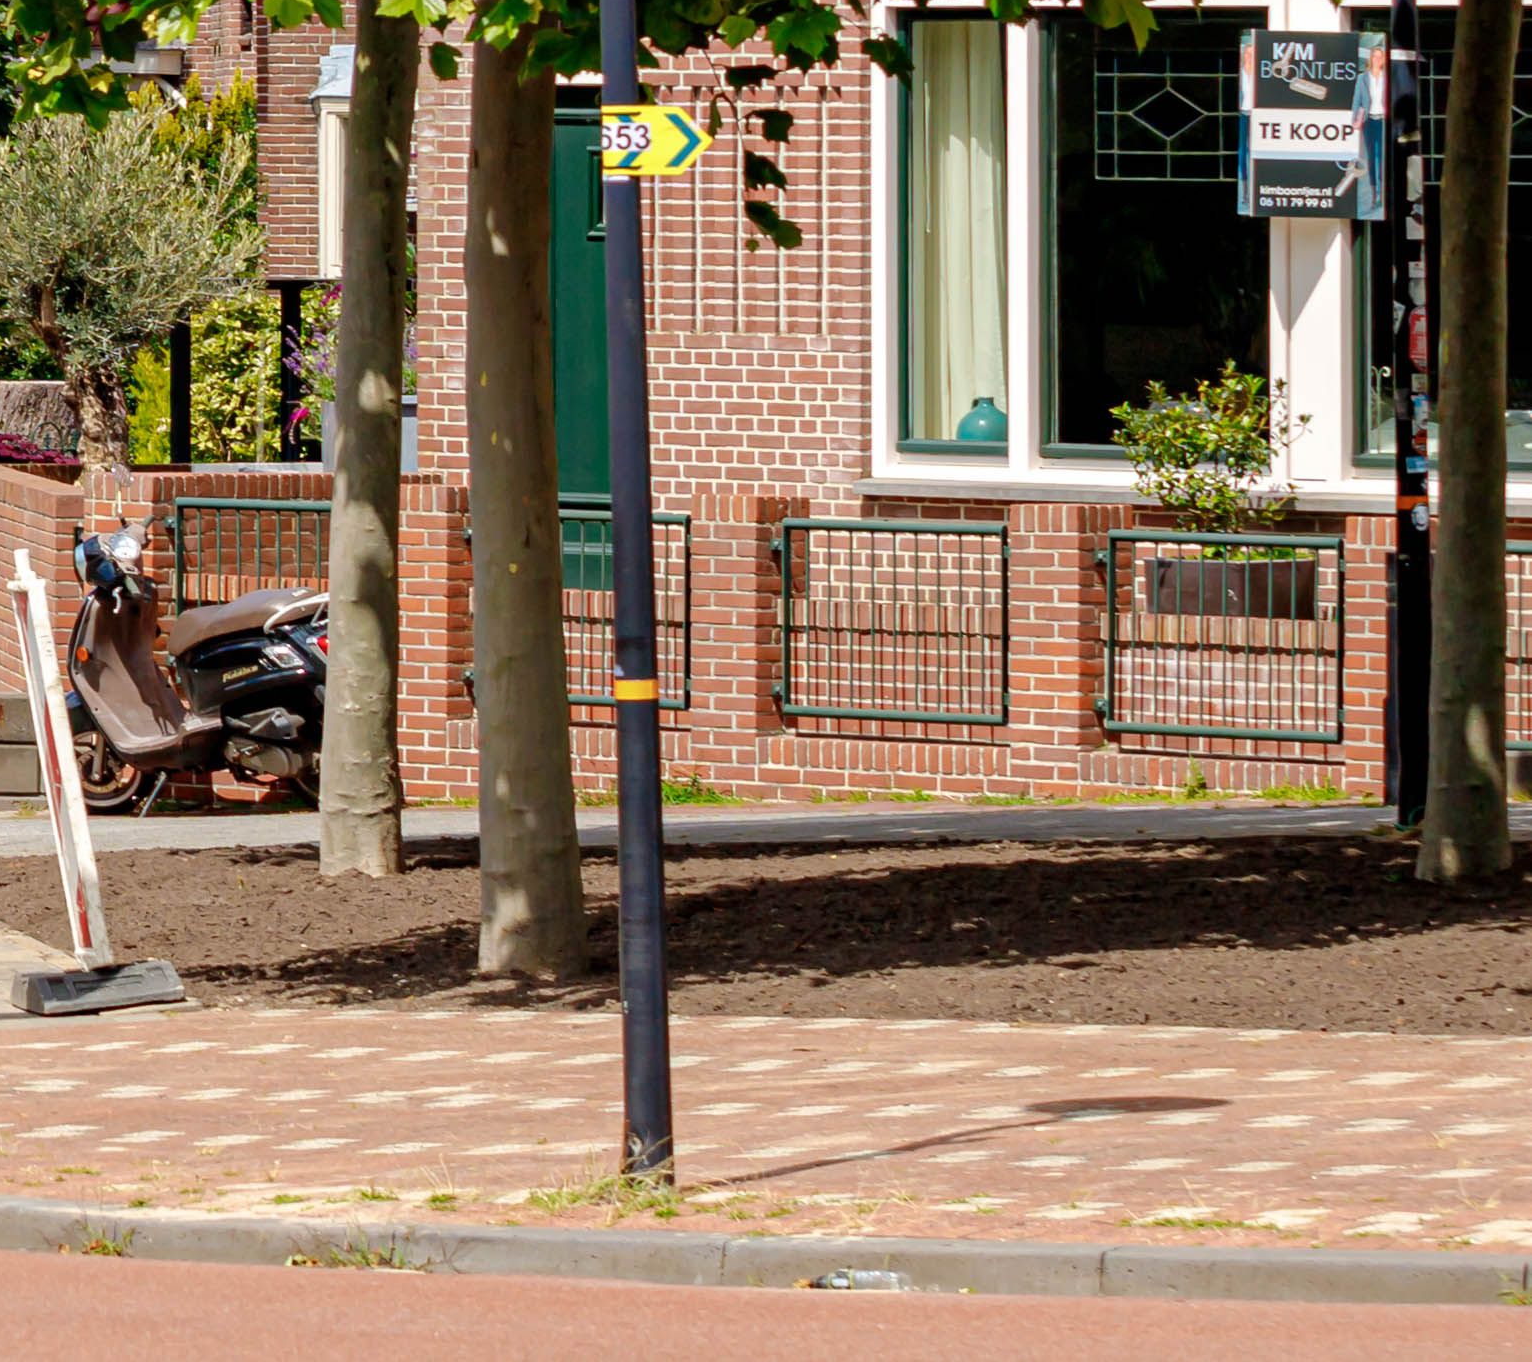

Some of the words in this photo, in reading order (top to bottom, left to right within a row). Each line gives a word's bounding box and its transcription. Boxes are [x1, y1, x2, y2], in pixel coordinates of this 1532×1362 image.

[1259, 123, 1281, 139] TE
[1290, 123, 1355, 141] KOOP
[1259, 197, 1274, 207] 06
[1275, 197, 1288, 207] 11
